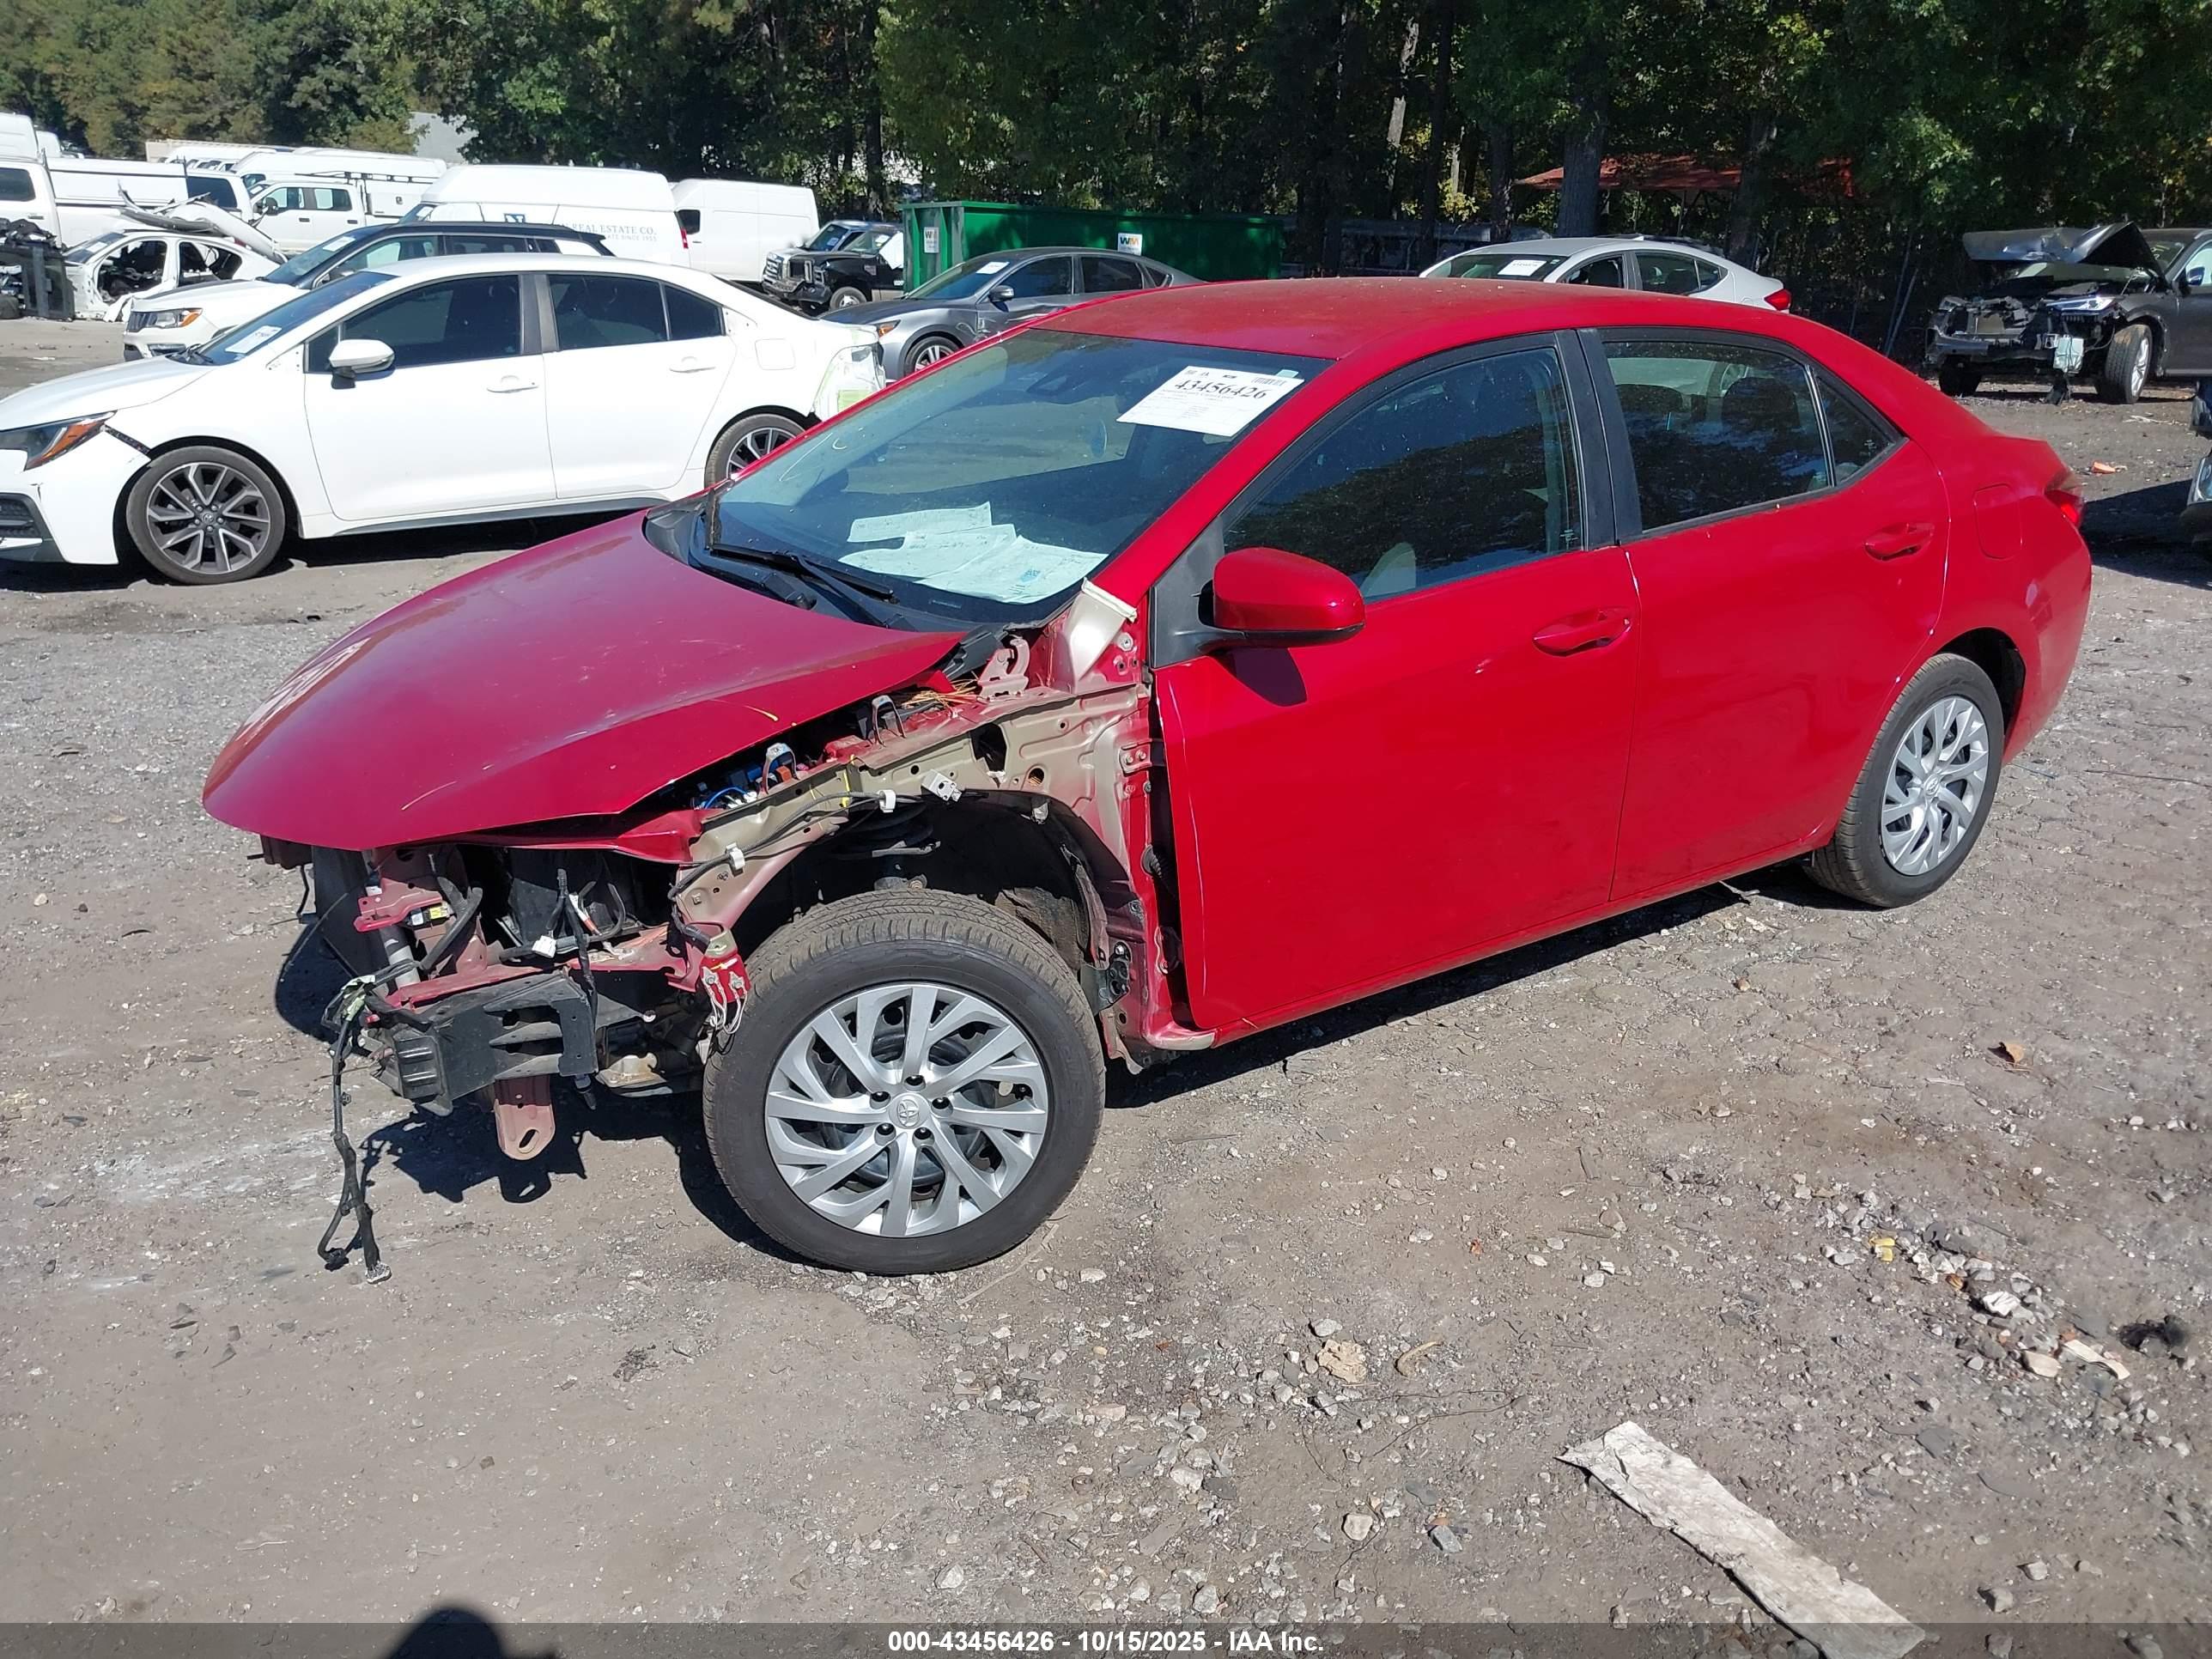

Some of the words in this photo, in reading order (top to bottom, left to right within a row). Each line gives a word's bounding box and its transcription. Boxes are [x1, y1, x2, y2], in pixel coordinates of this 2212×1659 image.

[600, 224, 637, 234] ESTATE
[640, 226, 658, 235] CO.
[1120, 236, 1139, 246] WM
[1175, 380, 1272, 399] 43456426
